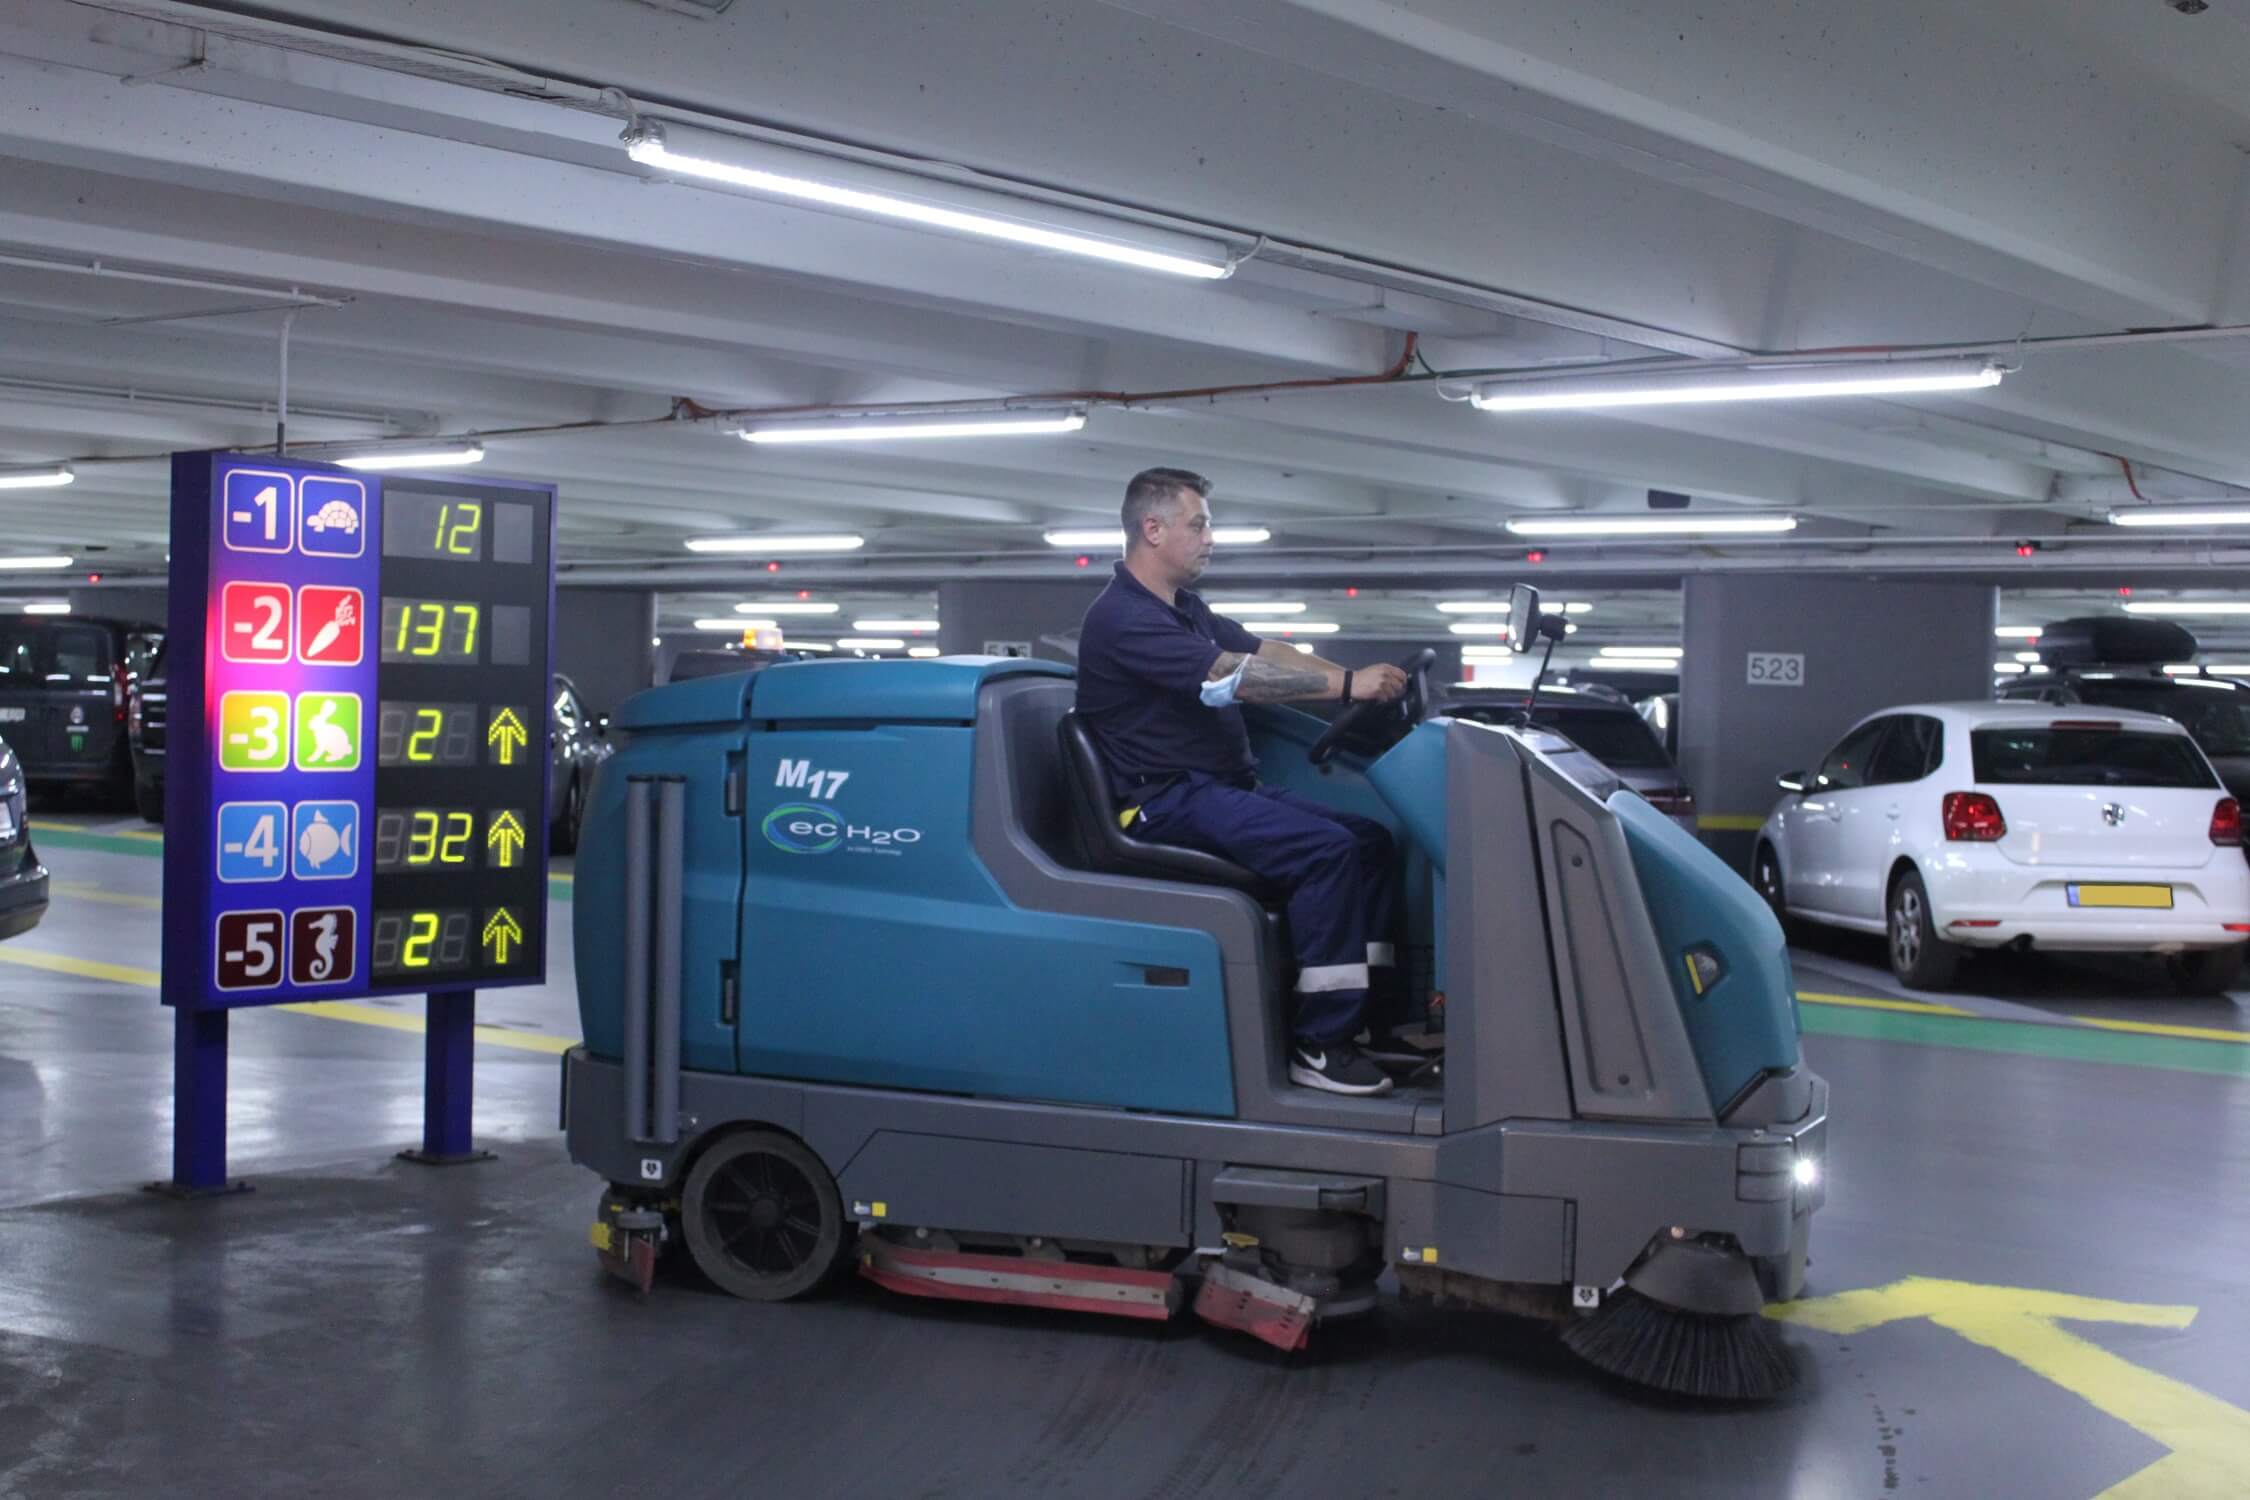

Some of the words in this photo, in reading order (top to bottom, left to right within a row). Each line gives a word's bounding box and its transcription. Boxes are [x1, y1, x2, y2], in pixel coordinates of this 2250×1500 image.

[232, 486, 278, 541] -1
[434, 503, 481, 555] 12
[233, 595, 284, 651] -2
[396, 604, 479, 656] 137
[229, 706, 280, 762] -3
[408, 709, 442, 761] 2
[775, 758, 849, 800] M17
[224, 814, 279, 868] -4
[407, 812, 473, 864] 32
[225, 922, 275, 977] -5
[403, 913, 439, 967] 2
